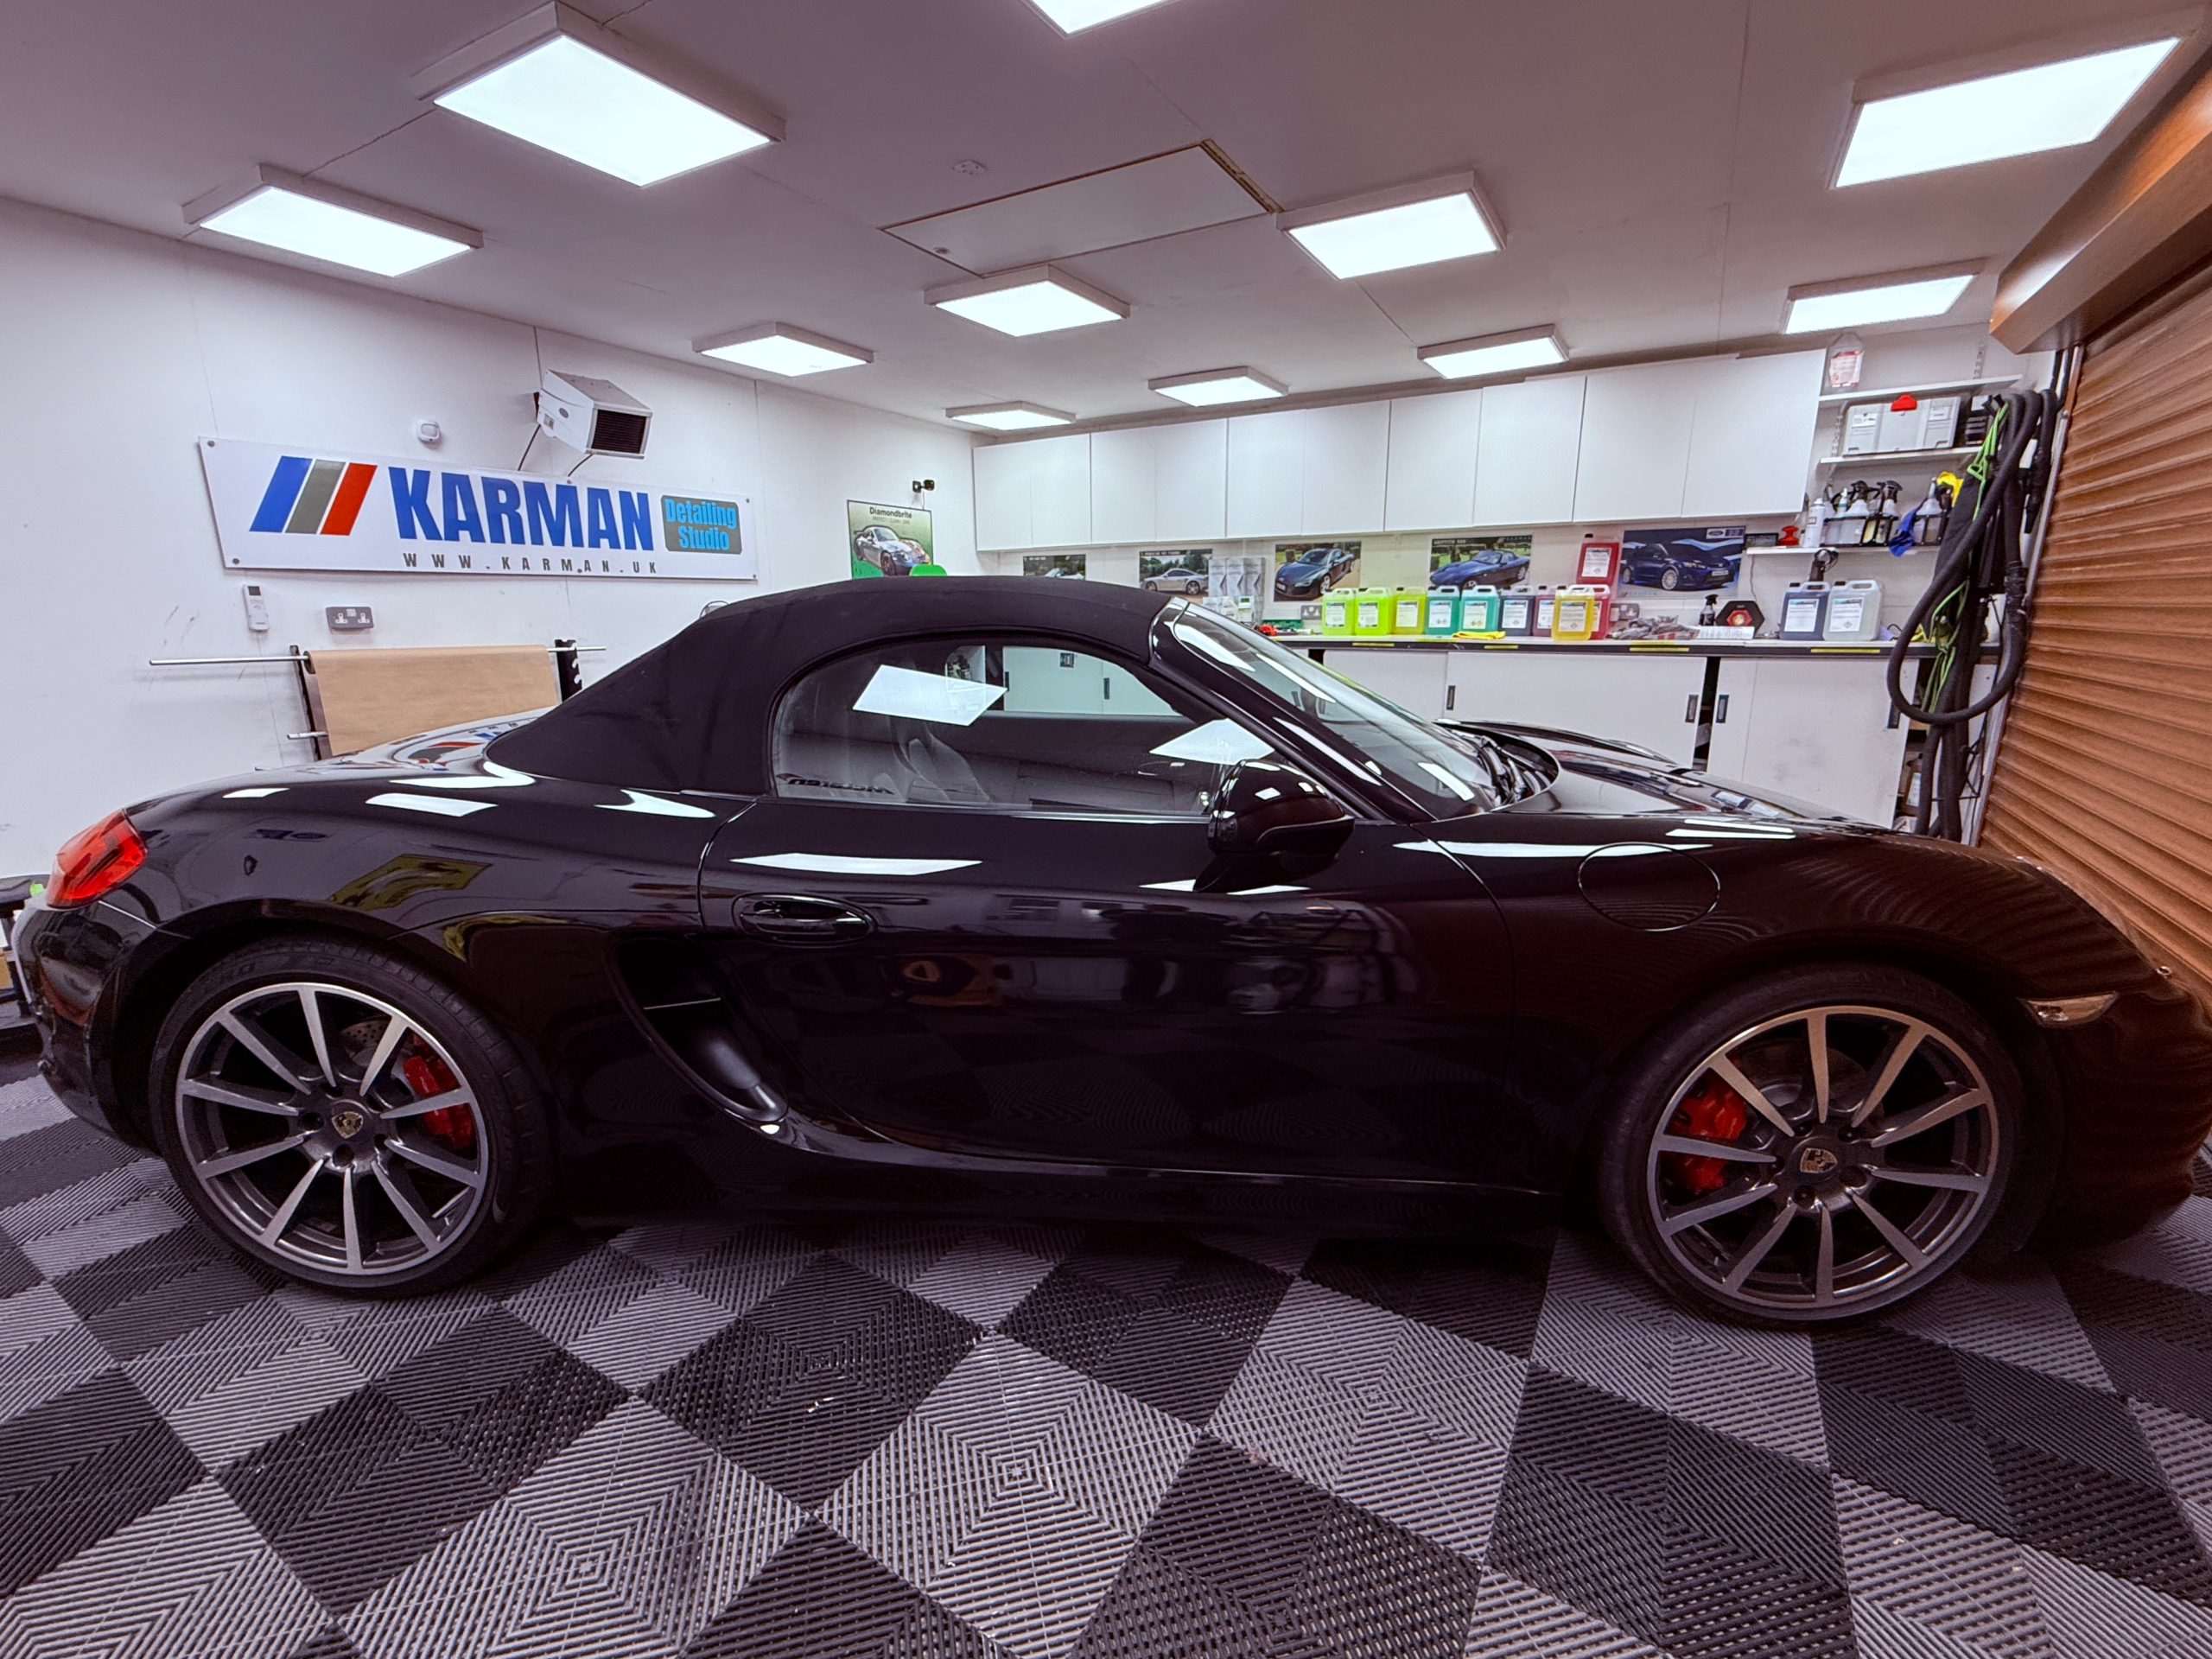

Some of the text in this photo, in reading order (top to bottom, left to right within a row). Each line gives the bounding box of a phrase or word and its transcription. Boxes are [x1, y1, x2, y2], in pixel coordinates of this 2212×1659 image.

[388, 467, 654, 551] KARMAN
[664, 499, 737, 529] Detailing
[869, 506, 912, 518] Diamondbrite
[678, 526, 729, 551] Studio
